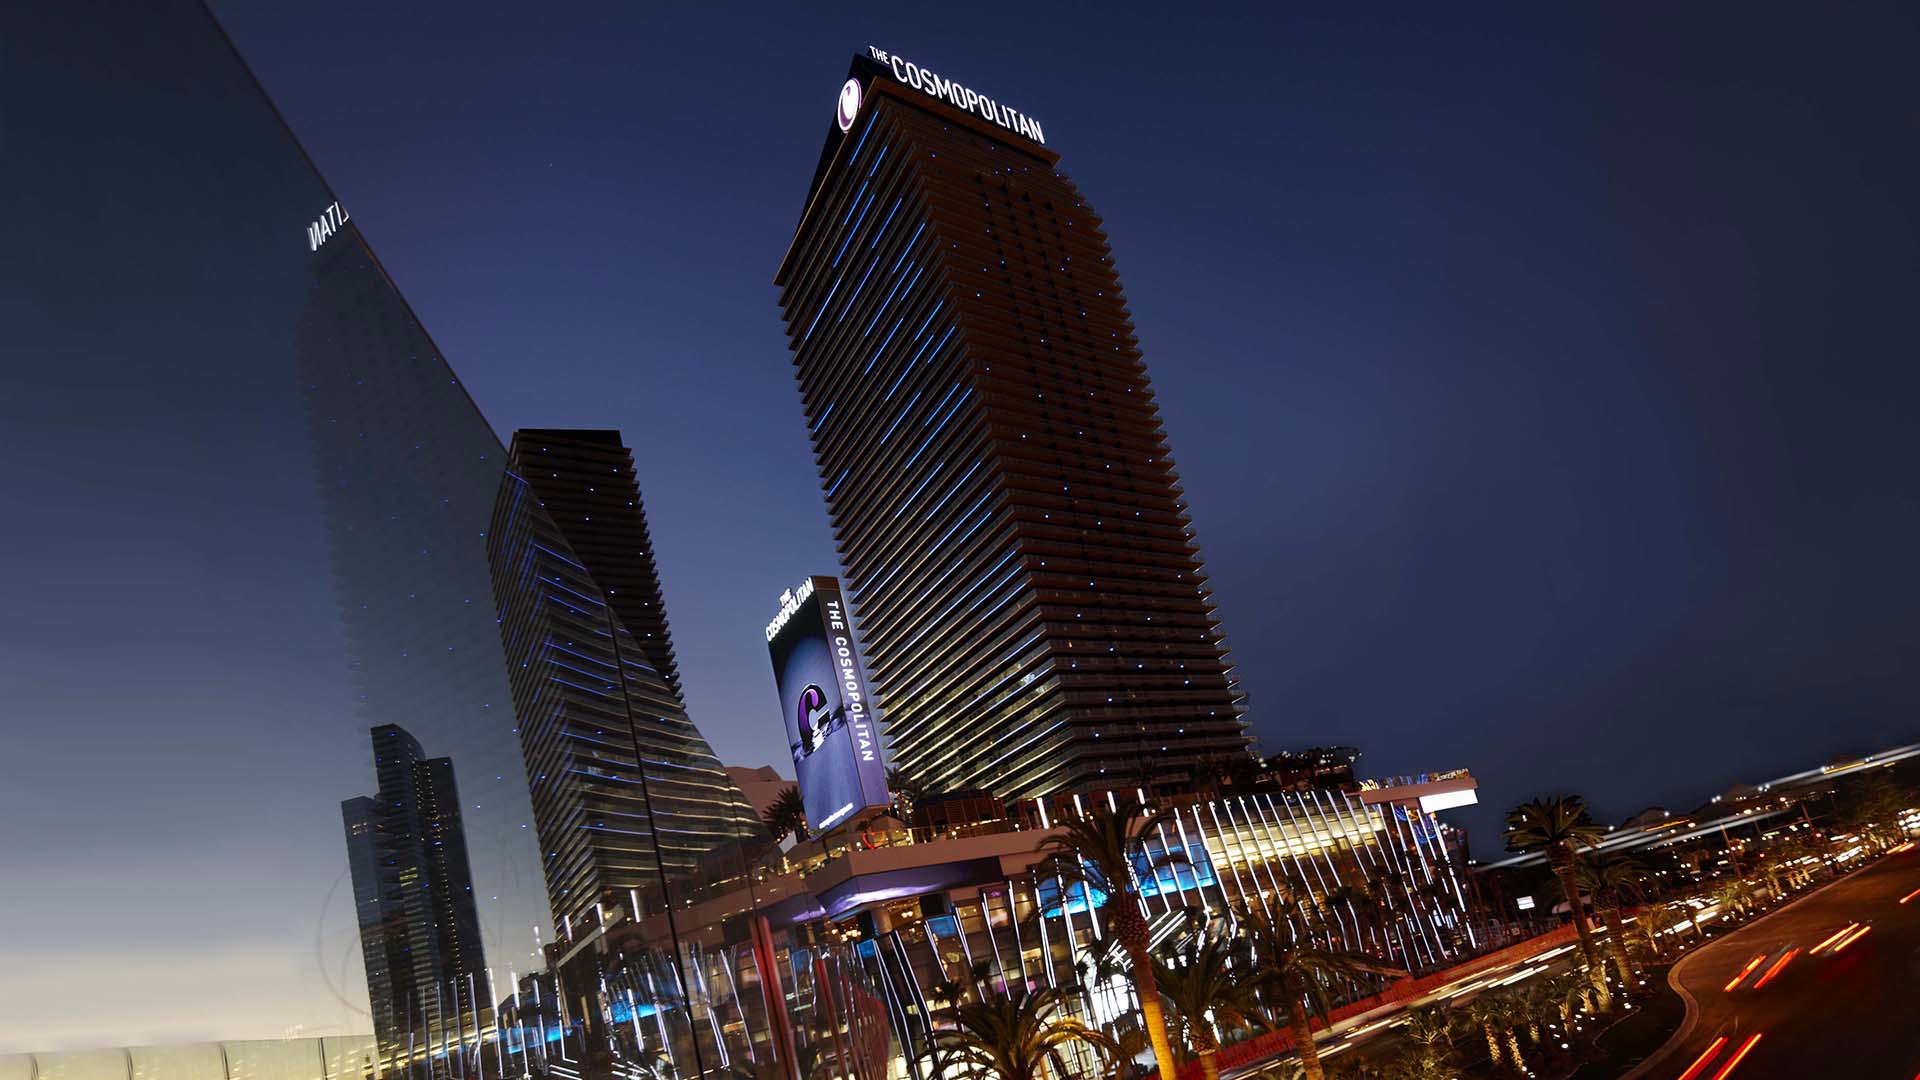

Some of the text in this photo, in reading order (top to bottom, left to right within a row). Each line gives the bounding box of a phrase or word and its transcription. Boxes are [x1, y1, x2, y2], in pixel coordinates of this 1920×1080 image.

[869, 45, 1046, 145] THE COSMOPOLITAN
[765, 576, 814, 642] COSMOPOLITAN
[779, 588, 792, 606] THE
[827, 600, 874, 761] THE COSMOPOLITAN
